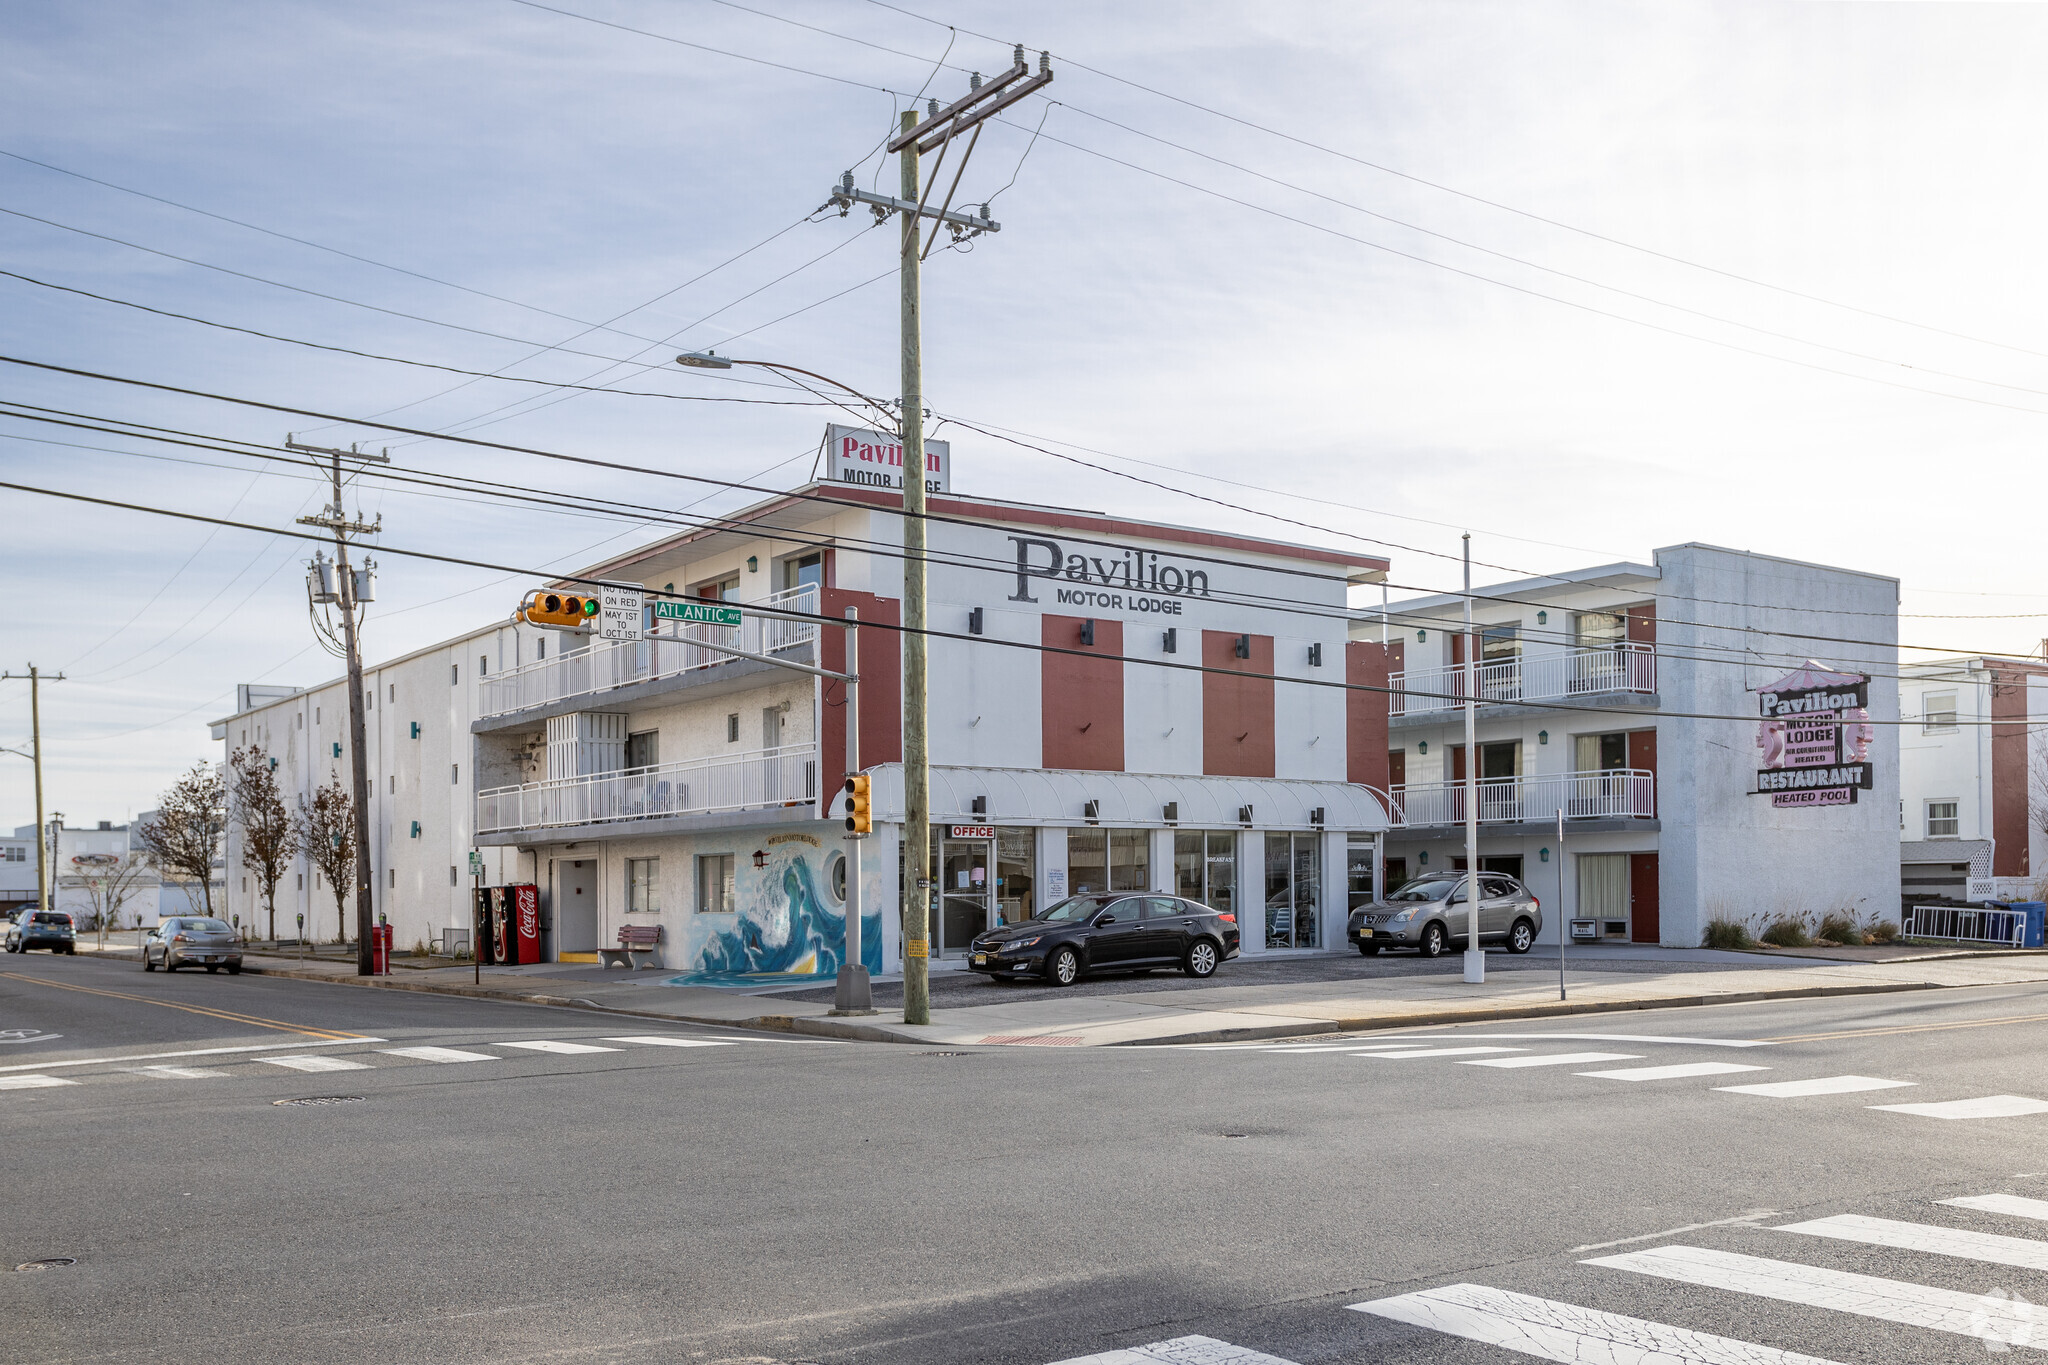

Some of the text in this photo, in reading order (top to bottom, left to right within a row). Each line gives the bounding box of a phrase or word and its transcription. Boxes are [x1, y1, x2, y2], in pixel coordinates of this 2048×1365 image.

[842, 437, 940, 472] Paviln
[844, 468, 891, 487] MOTOR
[1008, 536, 1210, 603] Pavilion
[605, 596, 635, 607] ON RED
[1057, 588, 1182, 615] MOTOR LODGE
[605, 610, 638, 621] MAY 1ST
[658, 602, 740, 622] ATLANTIC AVE
[616, 620, 627, 629] TO
[605, 628, 637, 639] OCT 1ST
[1761, 692, 1858, 716] Pavilion
[1786, 713, 1833, 730] MOTOR
[1786, 728, 1834, 744] LODGE
[1794, 755, 1826, 763] HEATED
[1758, 766, 1863, 790] RESTAURANT
[1774, 790, 1848, 804] HEATED POOL
[953, 826, 994, 837] OFFICE
[1206, 856, 1236, 864] BREAKFAST
